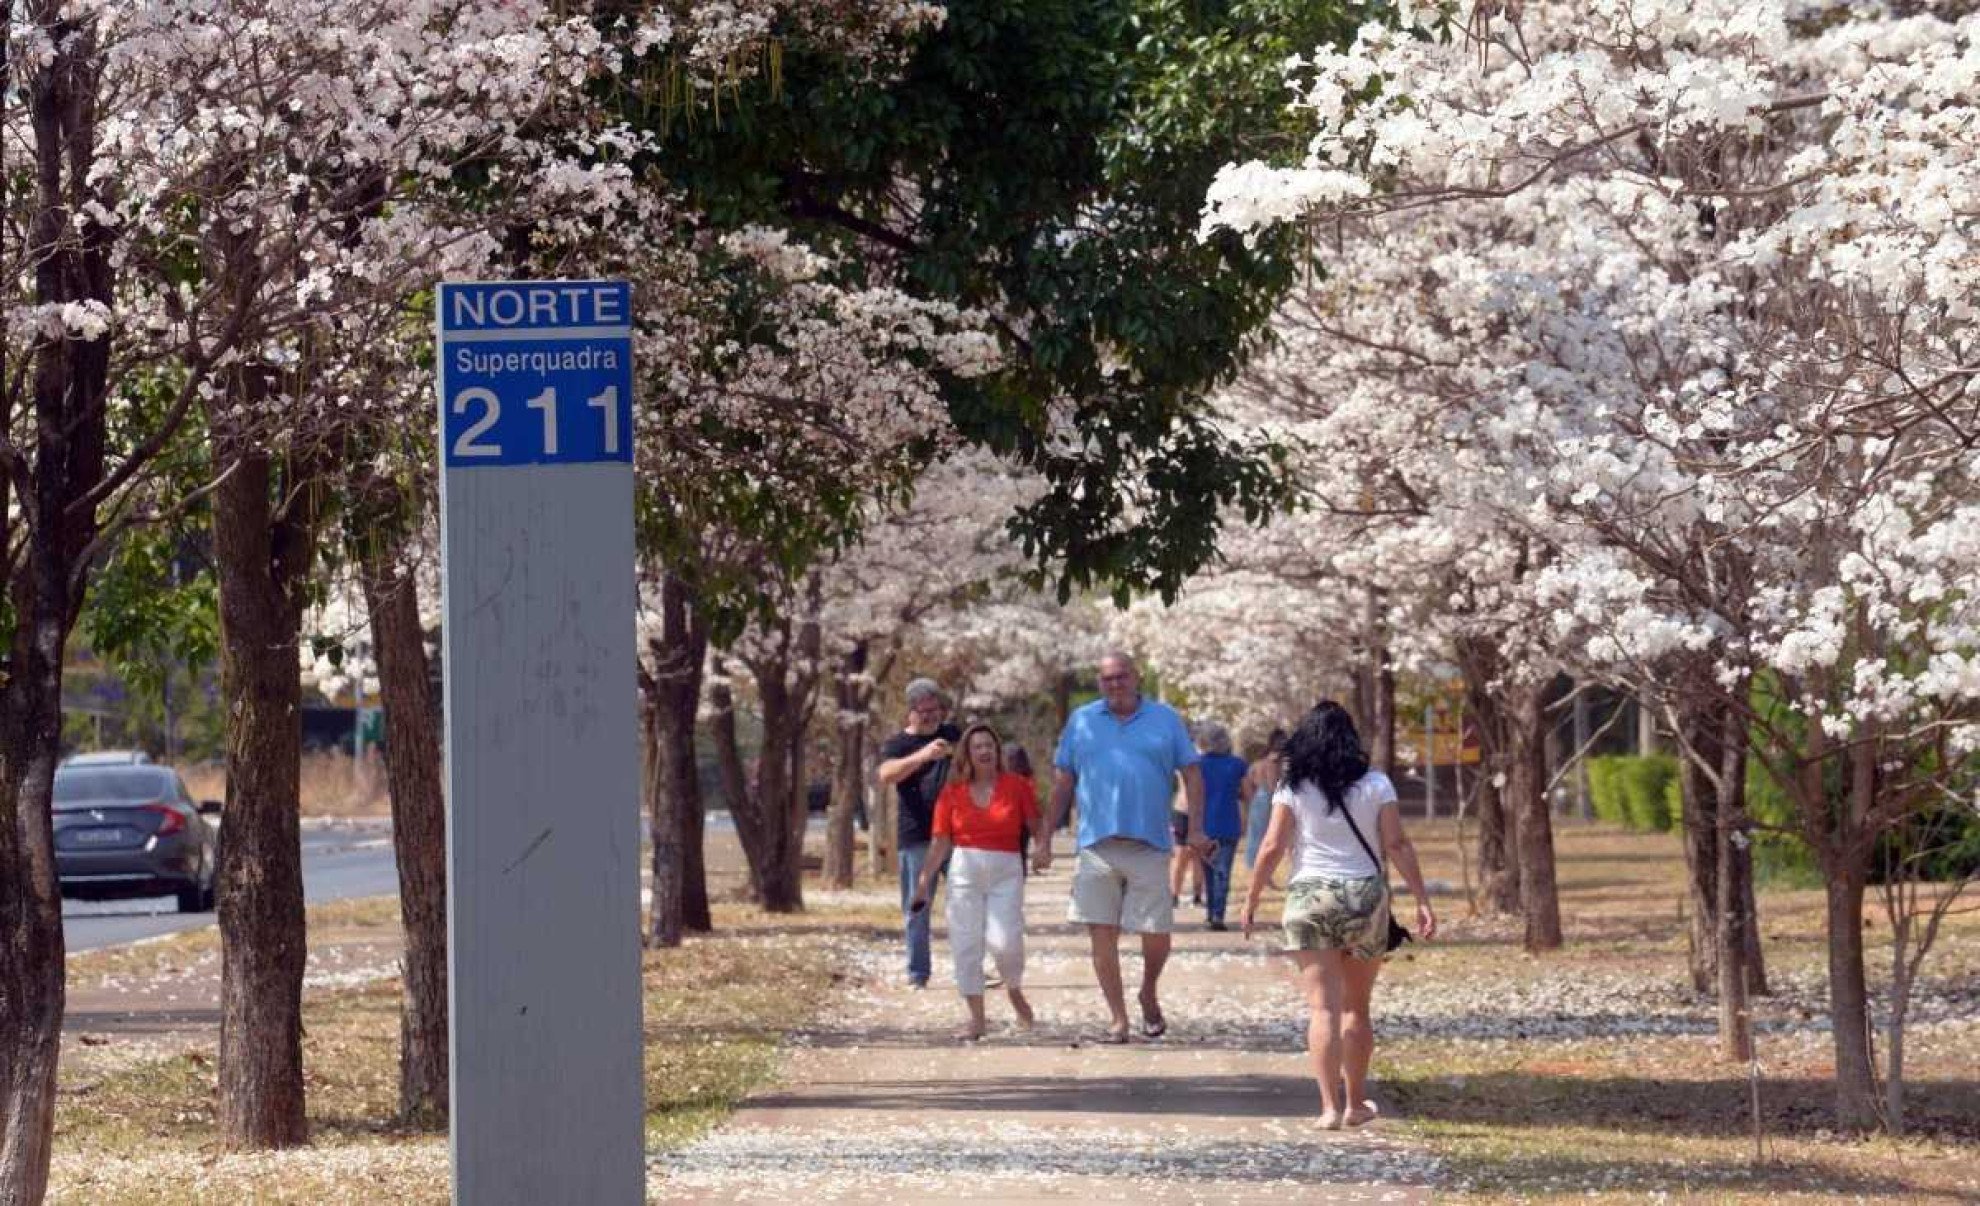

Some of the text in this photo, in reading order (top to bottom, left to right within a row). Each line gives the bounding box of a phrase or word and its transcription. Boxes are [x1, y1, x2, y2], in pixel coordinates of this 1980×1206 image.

[454, 288, 621, 326] NORTE
[456, 345, 618, 378] Superquadra
[453, 385, 619, 456] 211
